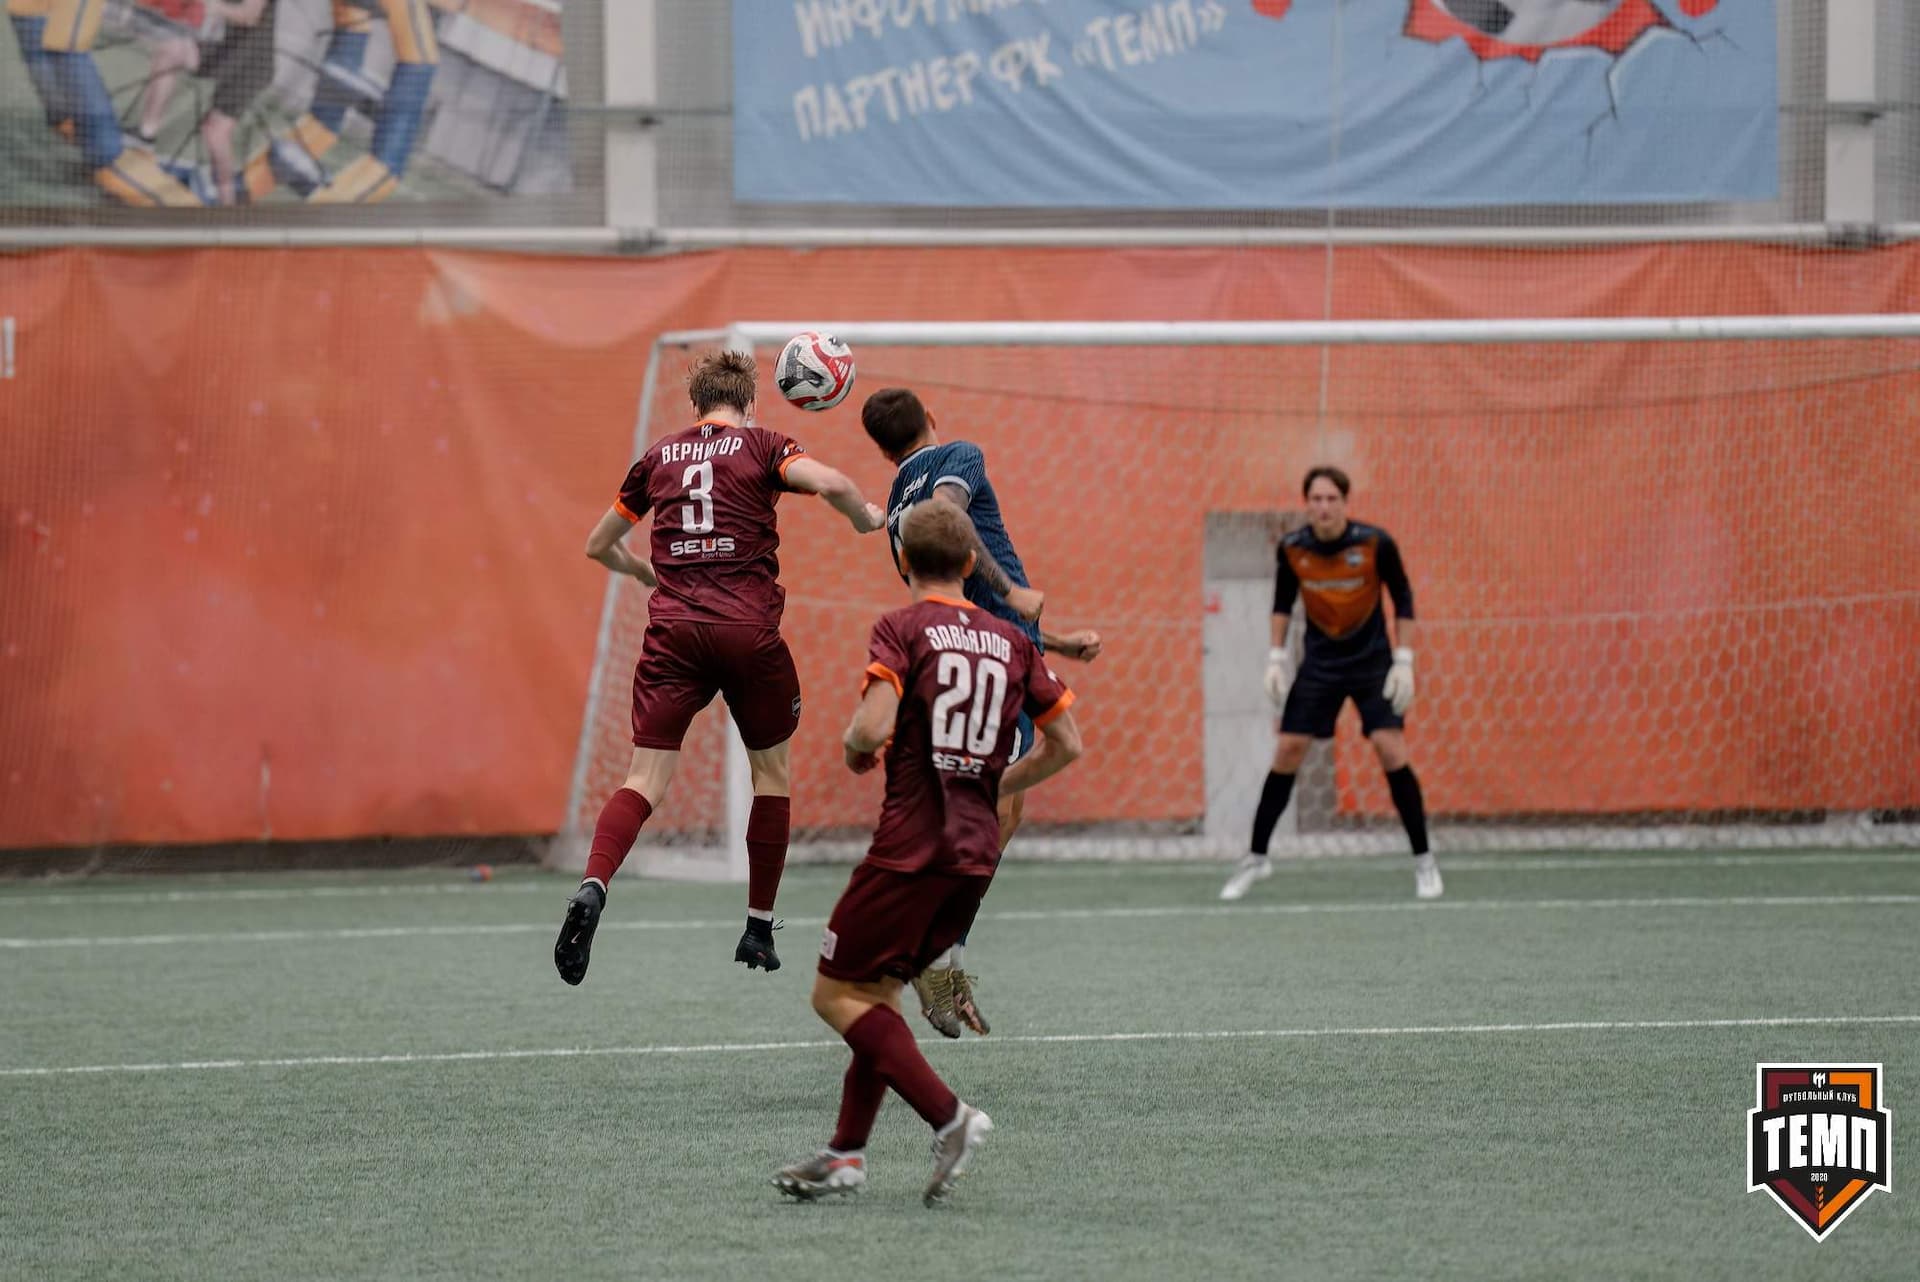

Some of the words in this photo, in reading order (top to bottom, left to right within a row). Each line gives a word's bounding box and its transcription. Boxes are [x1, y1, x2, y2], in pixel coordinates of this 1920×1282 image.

[793, 52, 980, 141] ПАРТНЕР
[989, 32, 1063, 92] ФК
[661, 436, 743, 465] ВЕРНИГОР
[682, 460, 714, 534] 3
[670, 537, 735, 557] SEUS
[925, 624, 1011, 664] ЗАВЬЯЛОВ
[931, 652, 1008, 756] 20
